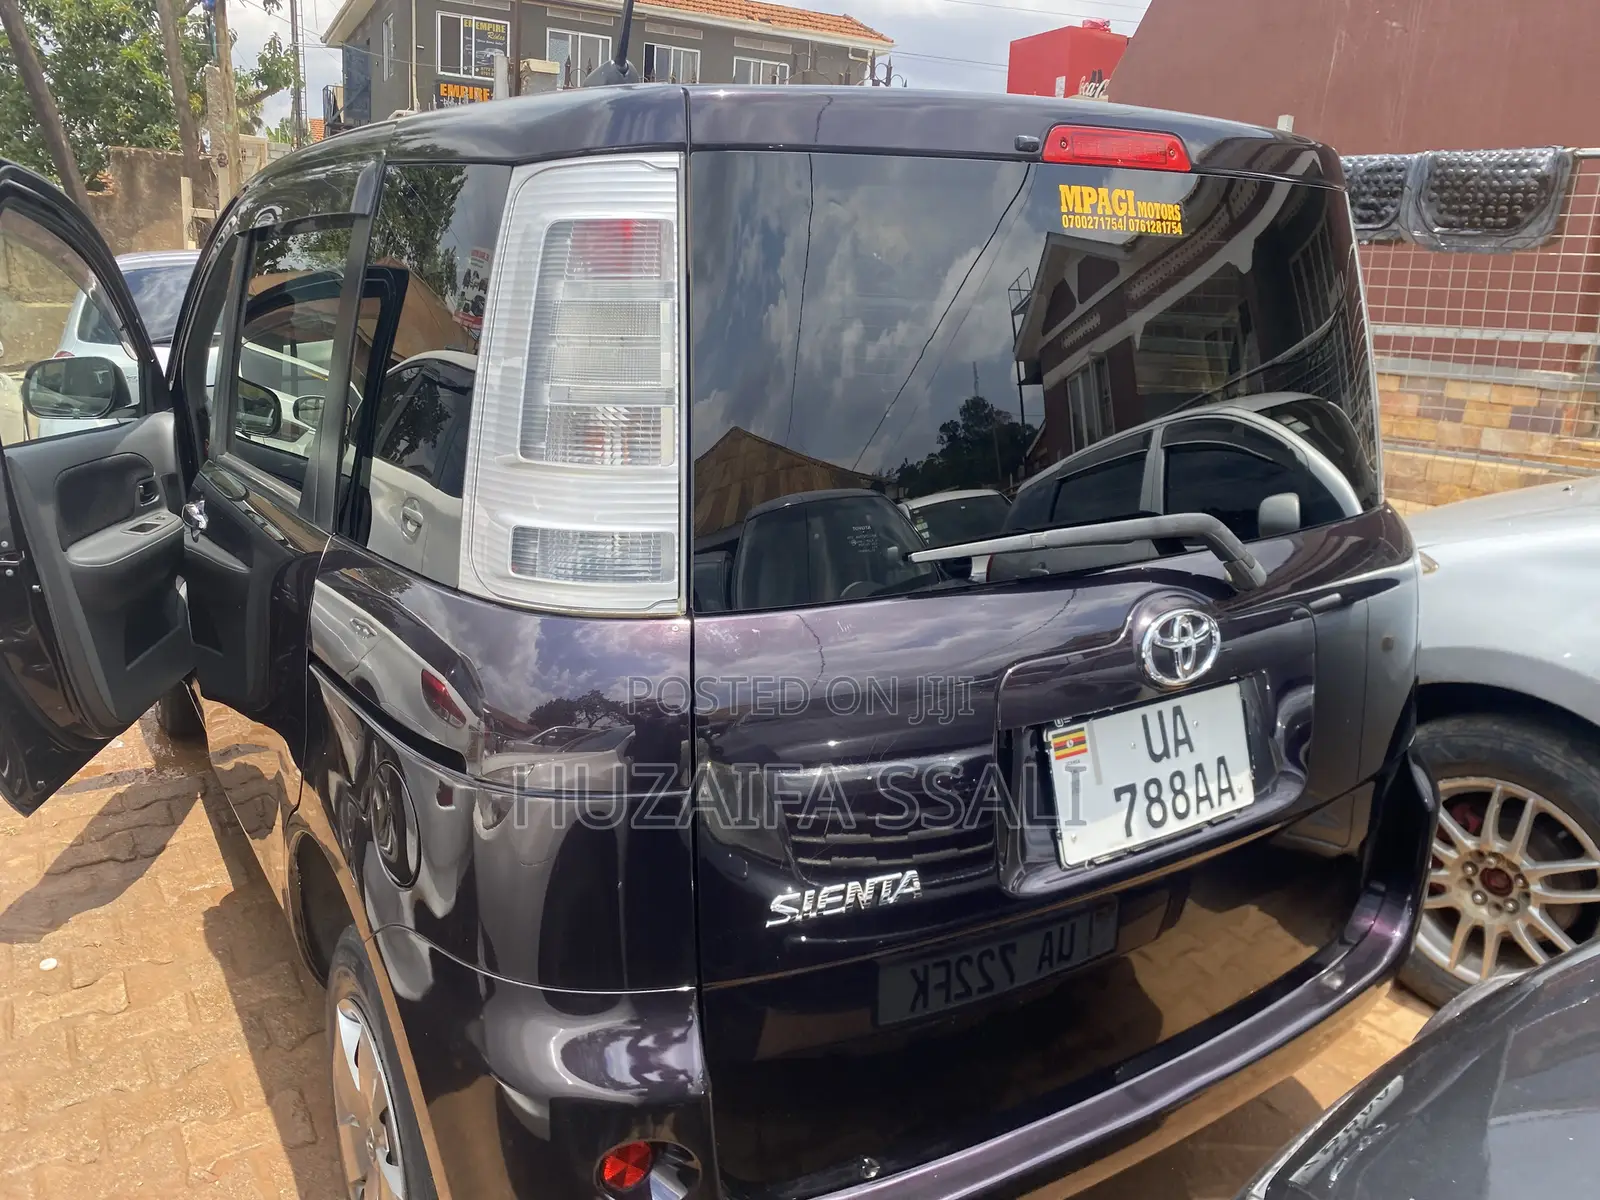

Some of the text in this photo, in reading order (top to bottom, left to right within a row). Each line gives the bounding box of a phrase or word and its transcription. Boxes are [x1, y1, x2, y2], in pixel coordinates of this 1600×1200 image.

[475, 21, 506, 33] EMPIRE
[440, 83, 490, 103] EMPIRE
[1058, 184, 1181, 222] MPAGI MOTORS
[1128, 218, 1183, 235] 0761281754
[1141, 704, 1195, 764] UA
[1113, 755, 1236, 838] 788AA
[765, 869, 923, 928] SIENTA
